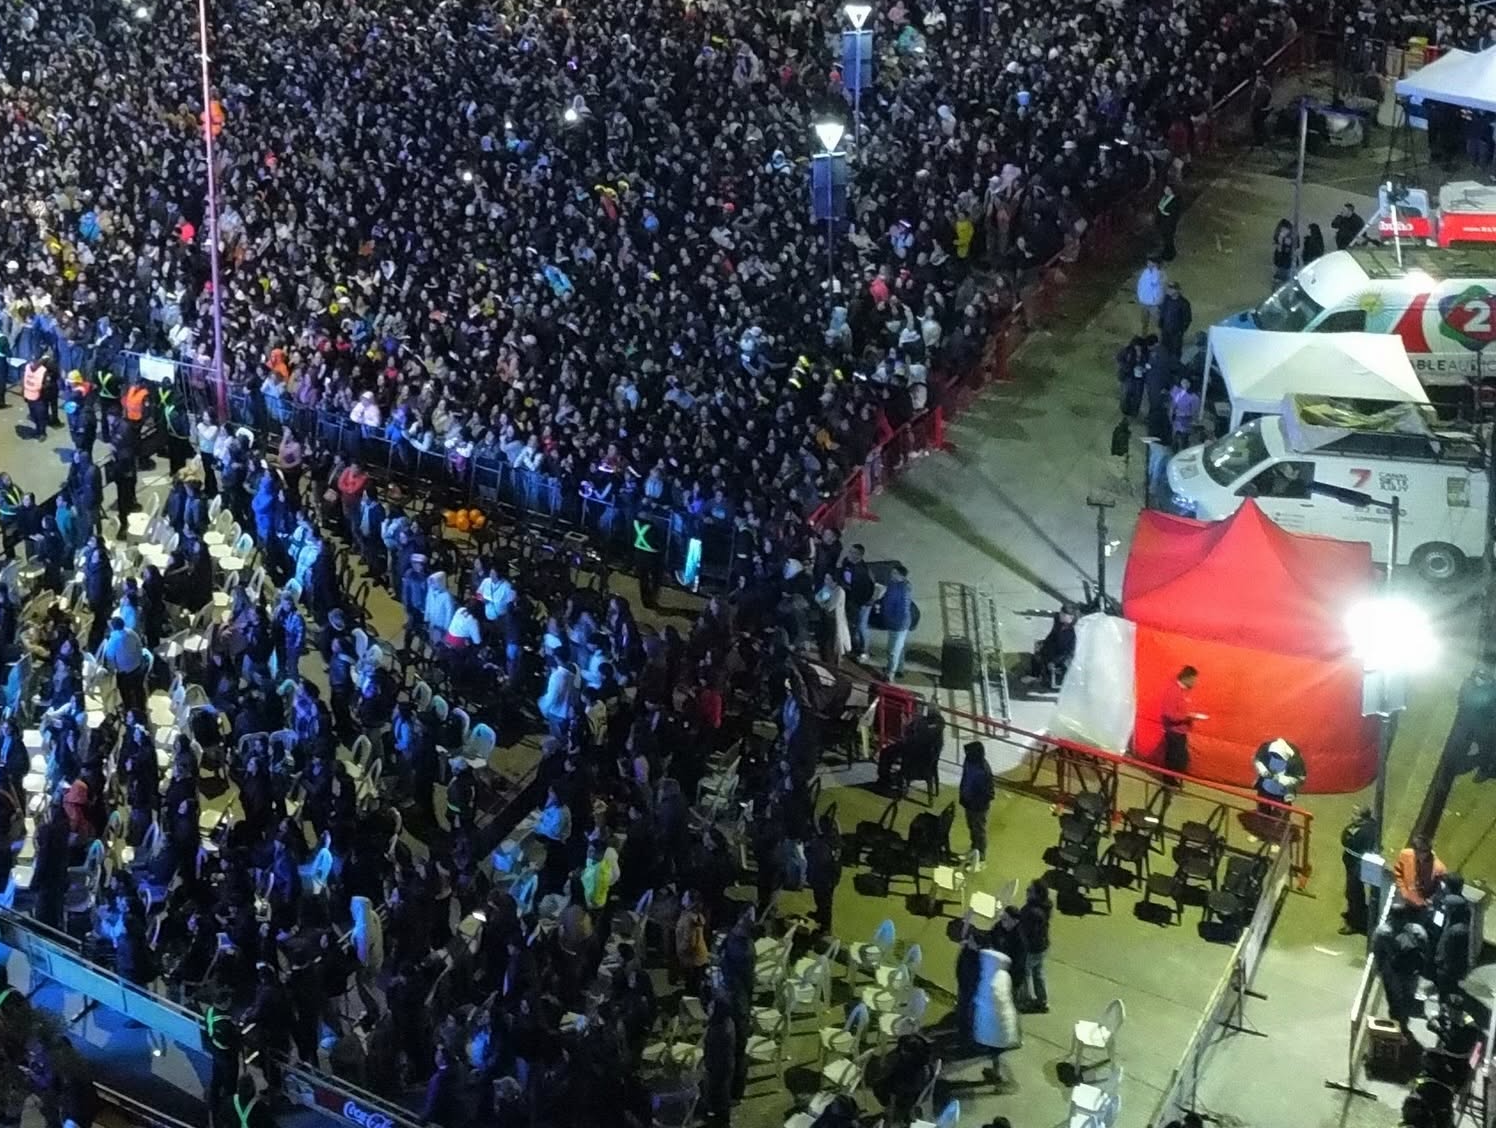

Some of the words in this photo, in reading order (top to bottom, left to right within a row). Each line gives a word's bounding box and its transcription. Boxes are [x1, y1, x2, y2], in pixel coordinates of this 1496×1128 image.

[1463, 300, 1492, 332] 2
[1350, 468, 1371, 488] 7
[343, 1101, 395, 1128] Coca-Col
